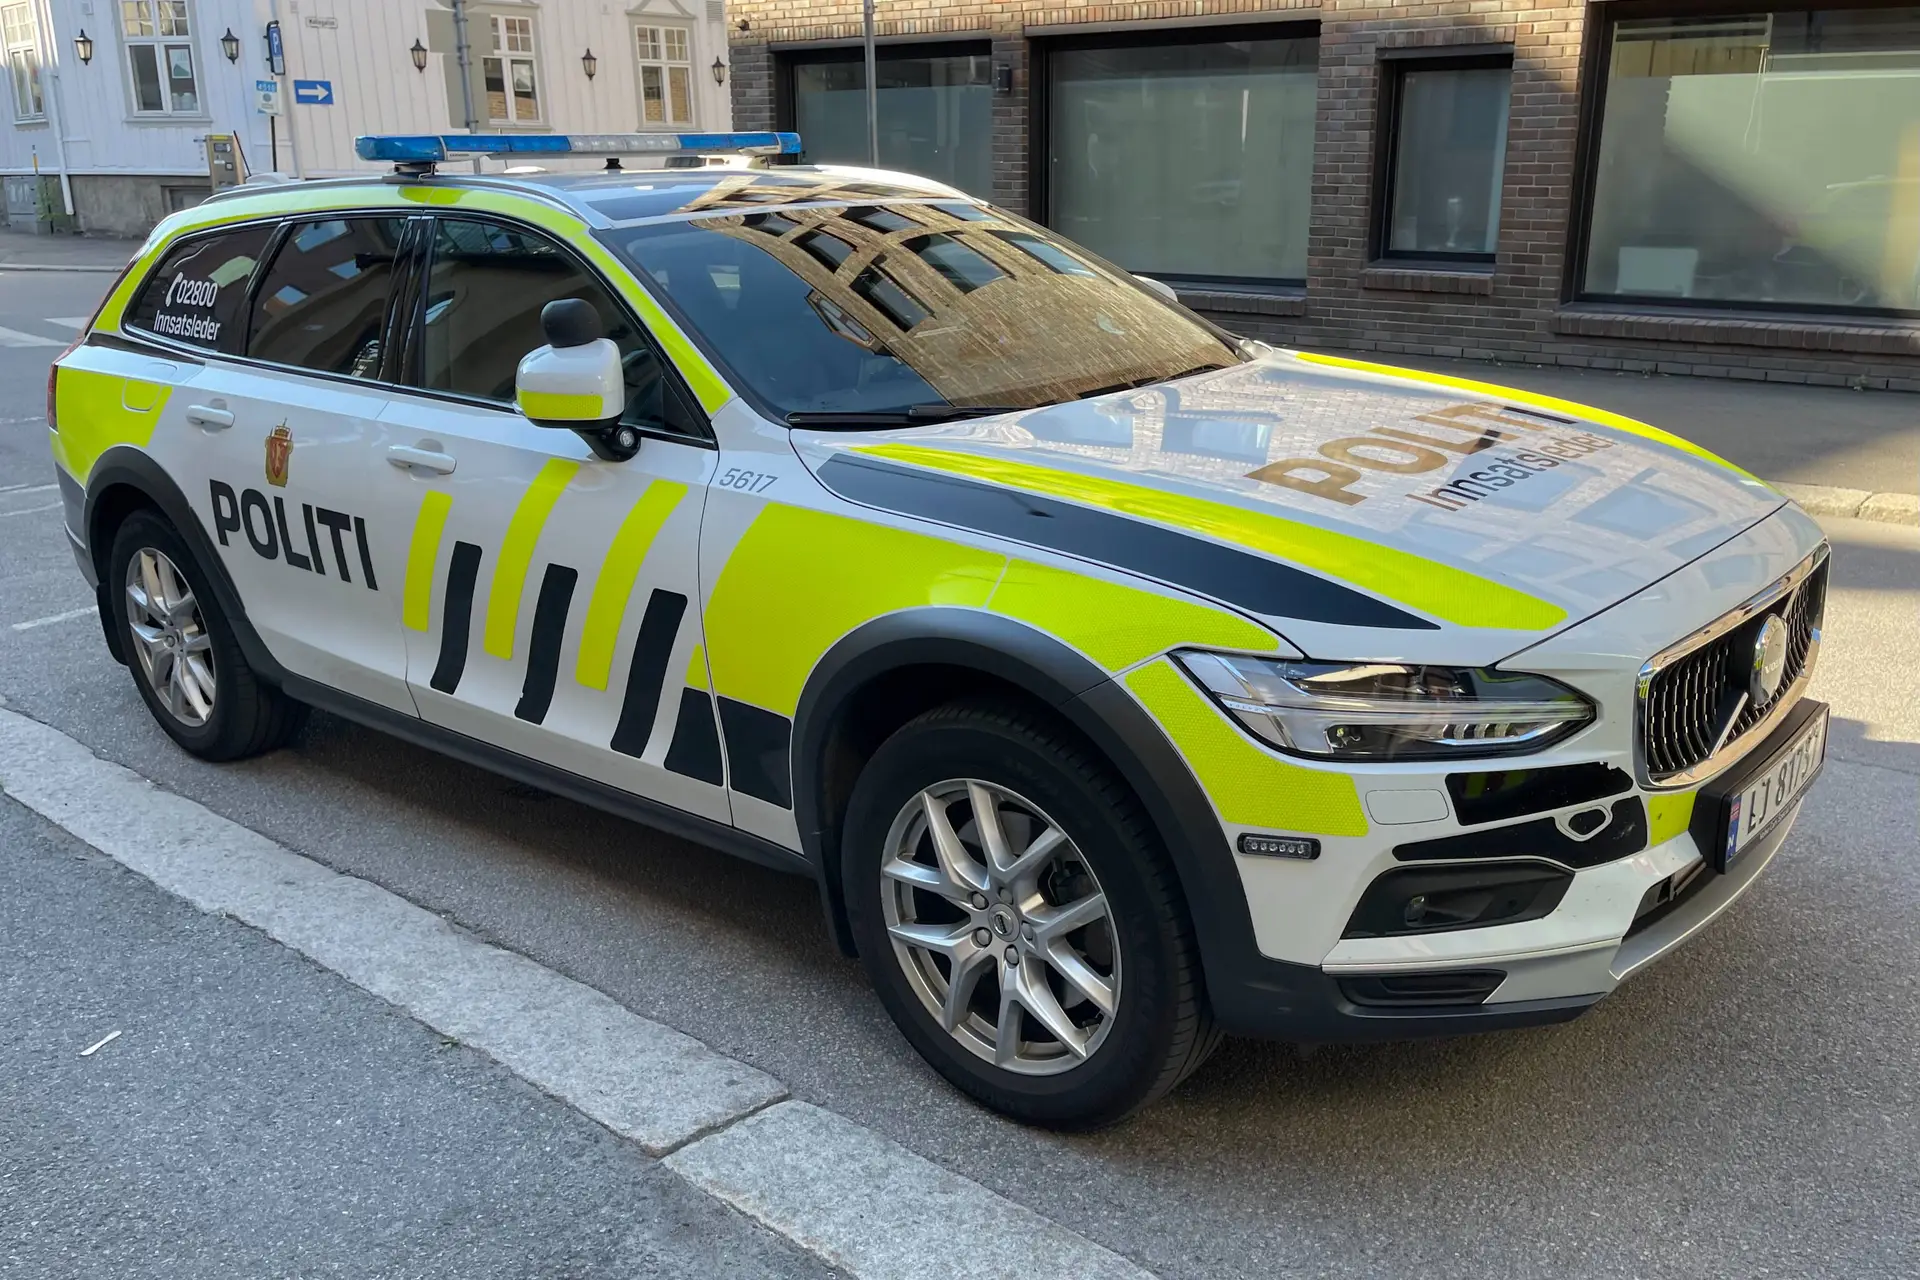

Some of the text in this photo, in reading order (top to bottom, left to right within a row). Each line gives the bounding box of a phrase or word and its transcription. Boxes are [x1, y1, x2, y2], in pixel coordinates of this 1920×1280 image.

[272, 32, 280, 54] P
[176, 279, 218, 308] 02800
[153, 310, 221, 341] Innsatsleder
[1243, 401, 1578, 506] POLITI
[719, 467, 779, 493] 5617
[1404, 433, 1618, 511] Innsatsleder
[209, 478, 379, 591] POLITI
[1727, 834, 1735, 850] N
